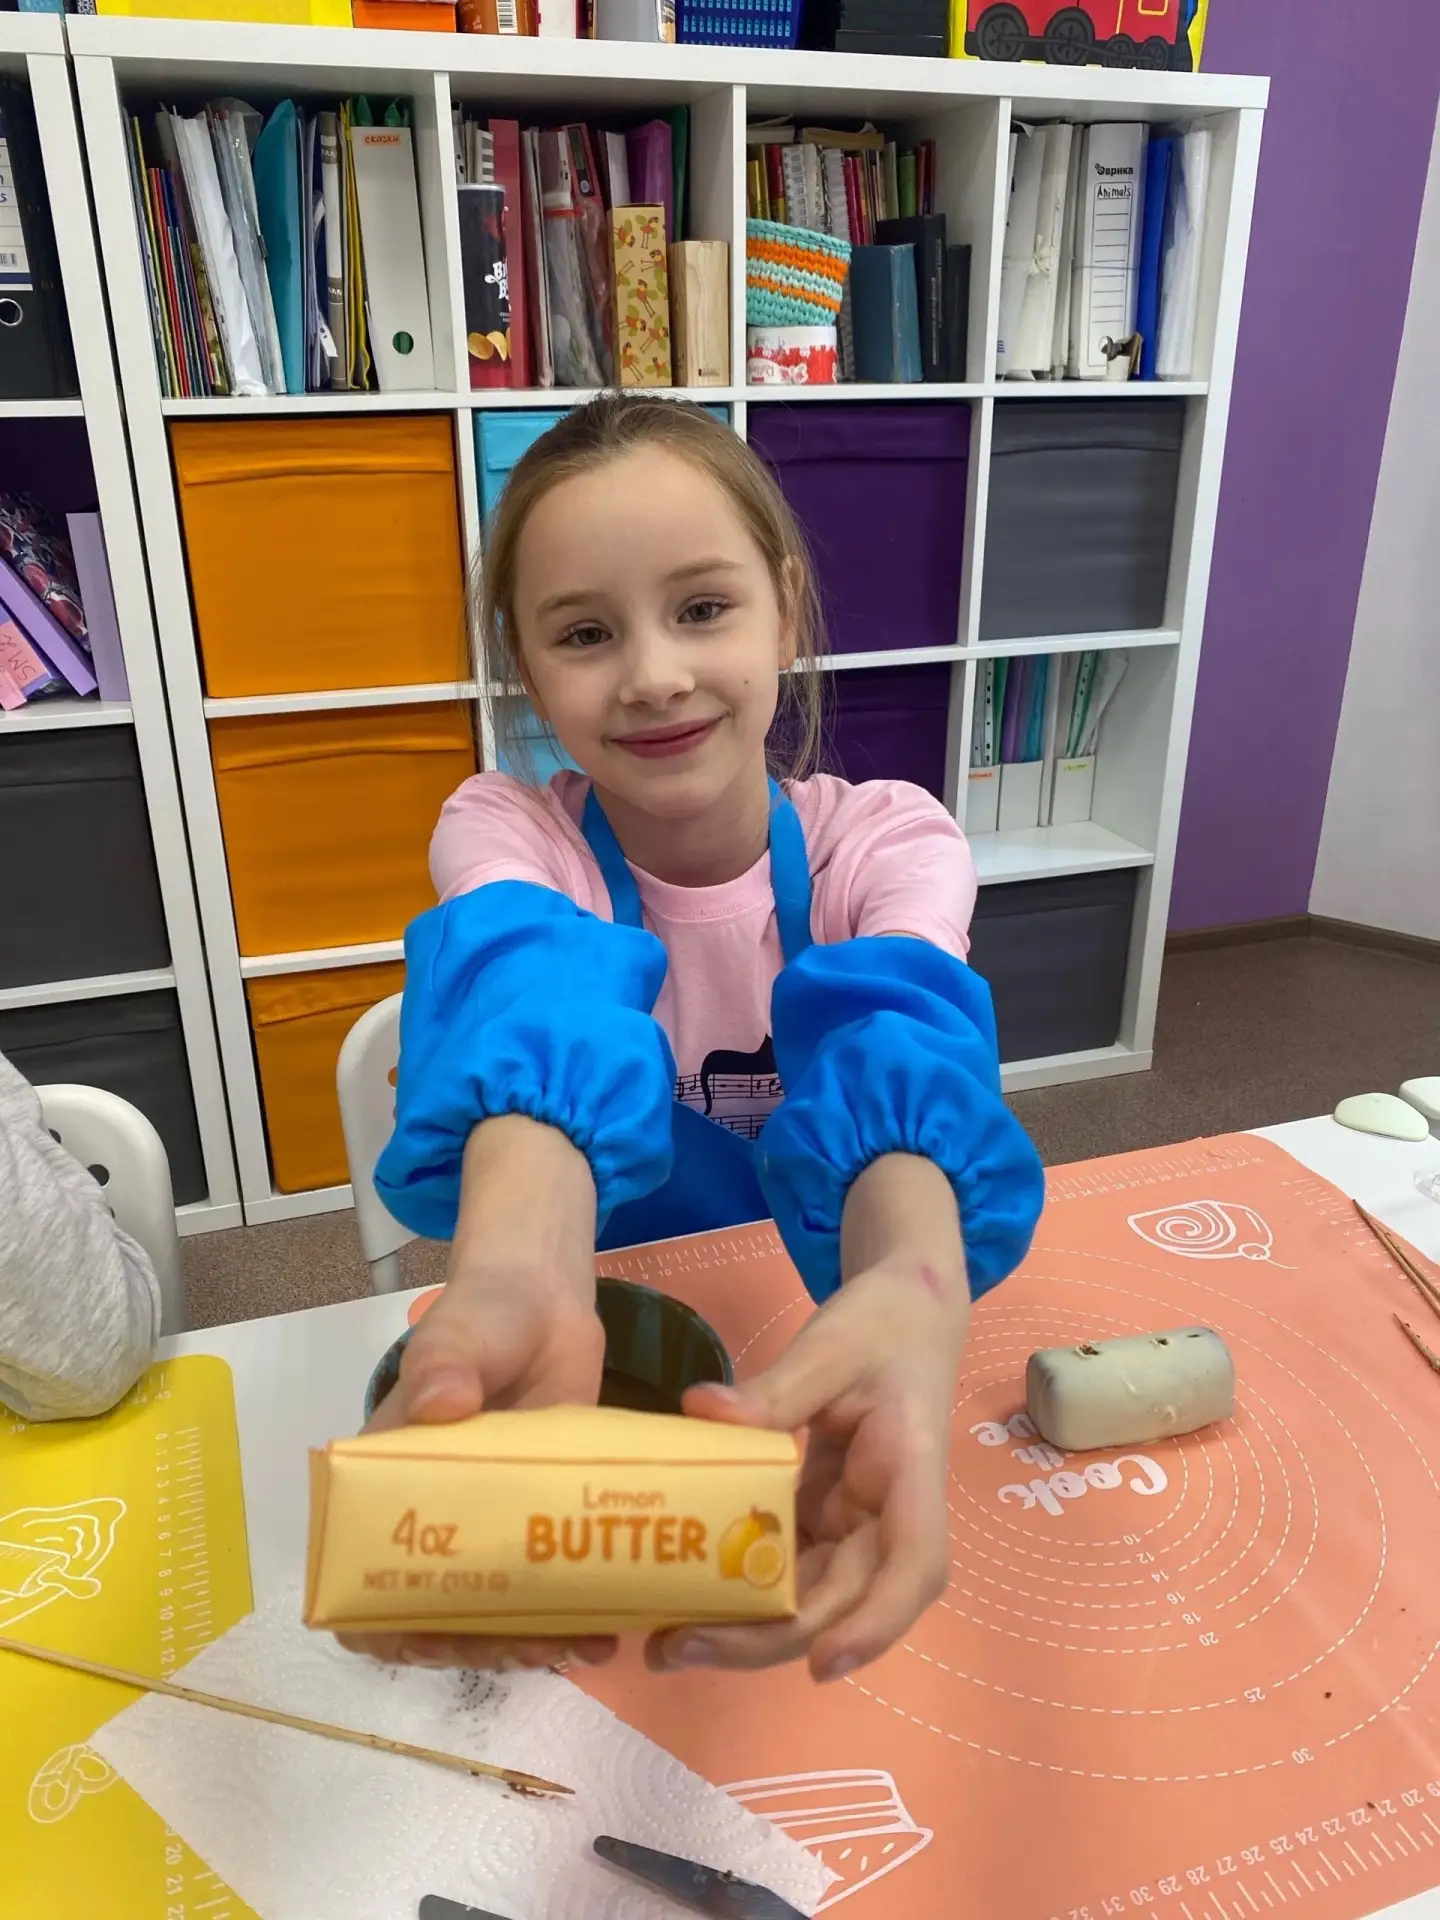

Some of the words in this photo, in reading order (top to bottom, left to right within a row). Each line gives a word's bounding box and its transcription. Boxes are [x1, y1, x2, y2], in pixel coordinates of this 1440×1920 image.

[1097, 184, 1131, 198] Animals
[582, 1482, 666, 1510] Lemon
[526, 1513, 707, 1564] BUTTER
[1123, 1533, 1141, 1545] 10
[1136, 1551, 1155, 1564] 12
[1151, 1570, 1170, 1584] 14
[1166, 1591, 1186, 1605] 16
[1182, 1611, 1202, 1625] 18
[1199, 1632, 1219, 1646] 20
[1244, 1687, 1266, 1703] 25
[1291, 1747, 1314, 1764] 30
[1400, 1788, 1424, 1807] 20
[1346, 1808, 1372, 1826] 22
[1374, 1799, 1397, 1818] 21
[1321, 1817, 1346, 1836] 23
[1269, 1835, 1294, 1855] 25
[1294, 1827, 1318, 1846] 24
[165, 1843, 182, 1865] 20
[1240, 1845, 1265, 1865] 26
[1216, 1856, 1239, 1875] 27
[166, 1873, 183, 1895] 21
[1157, 1875, 1182, 1895] 29
[1185, 1866, 1211, 1886] 28
[1129, 1886, 1155, 1905] 30
[1100, 1896, 1125, 1916] 31
